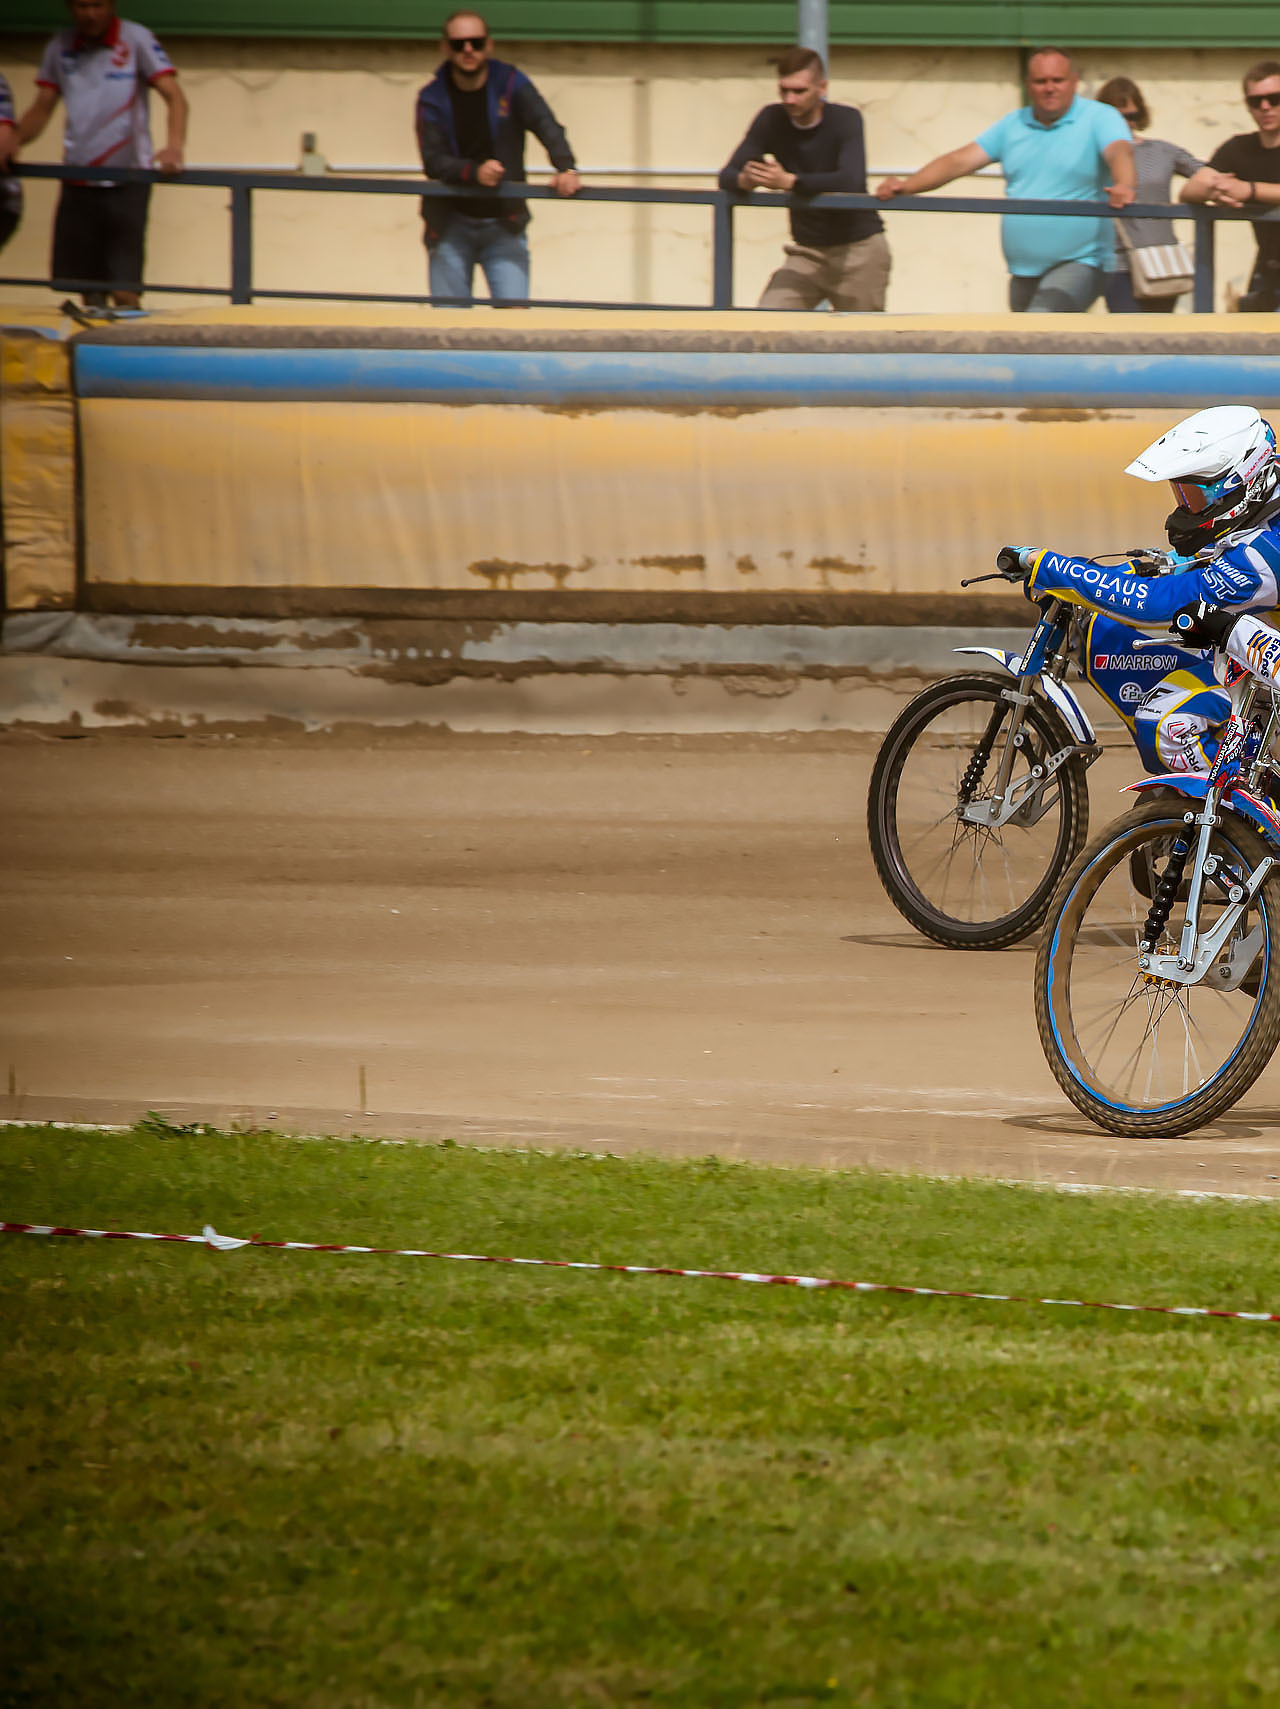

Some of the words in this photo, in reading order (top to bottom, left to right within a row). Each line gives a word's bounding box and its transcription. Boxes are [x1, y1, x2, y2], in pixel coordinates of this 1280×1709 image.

[1047, 556, 1149, 598] NICOLAUS
[1095, 588, 1145, 611] BANK
[1110, 655, 1177, 671] MARROW
